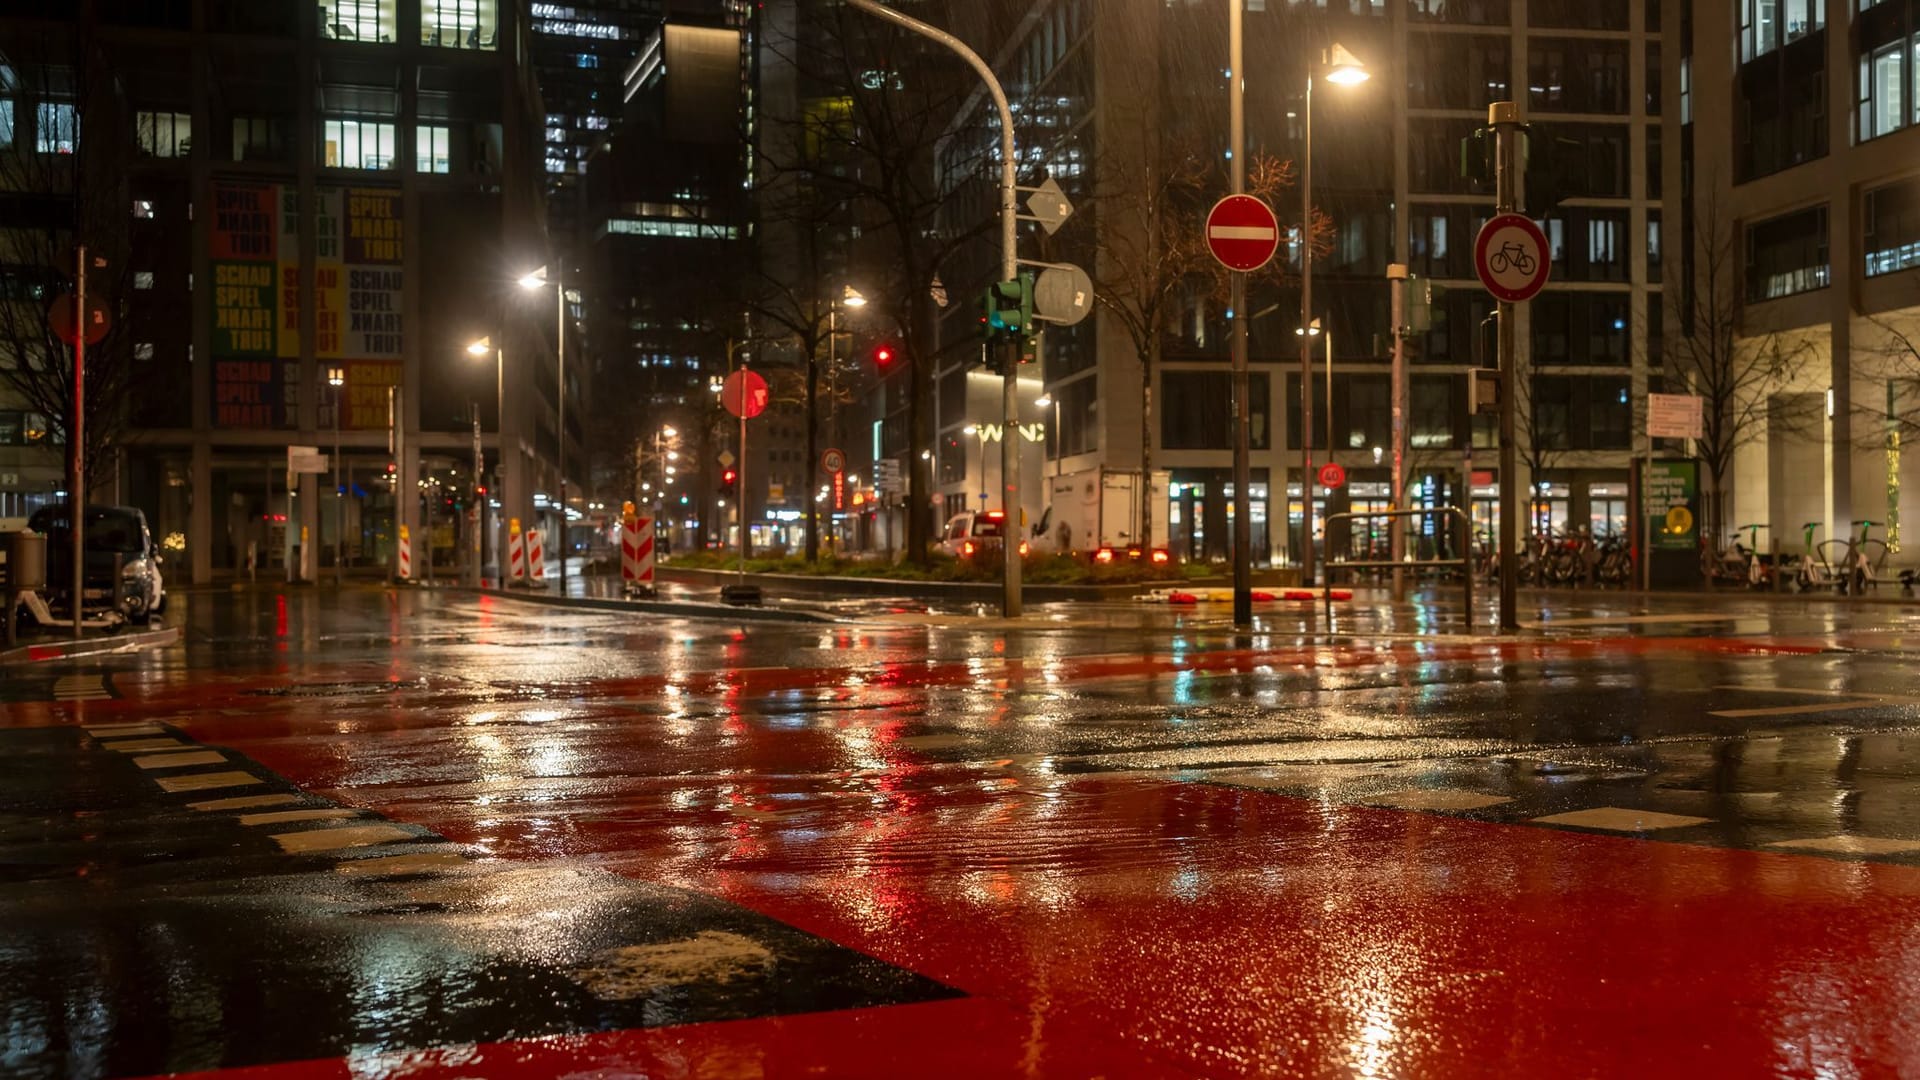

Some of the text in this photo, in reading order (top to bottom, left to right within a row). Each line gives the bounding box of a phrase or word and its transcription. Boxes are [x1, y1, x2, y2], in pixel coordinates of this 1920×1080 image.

[349, 197, 391, 217] SPIEL
[216, 265, 271, 287] SCHAU
[350, 271, 402, 290] SCHAU
[216, 287, 260, 307] SPIEL
[350, 292, 391, 311] SPIEL
[216, 361, 271, 382] SCHAU
[350, 363, 402, 385] SCHAU
[216, 383, 260, 403] SPIEL
[827, 455, 840, 468] 40
[1325, 471, 1340, 480] 40
